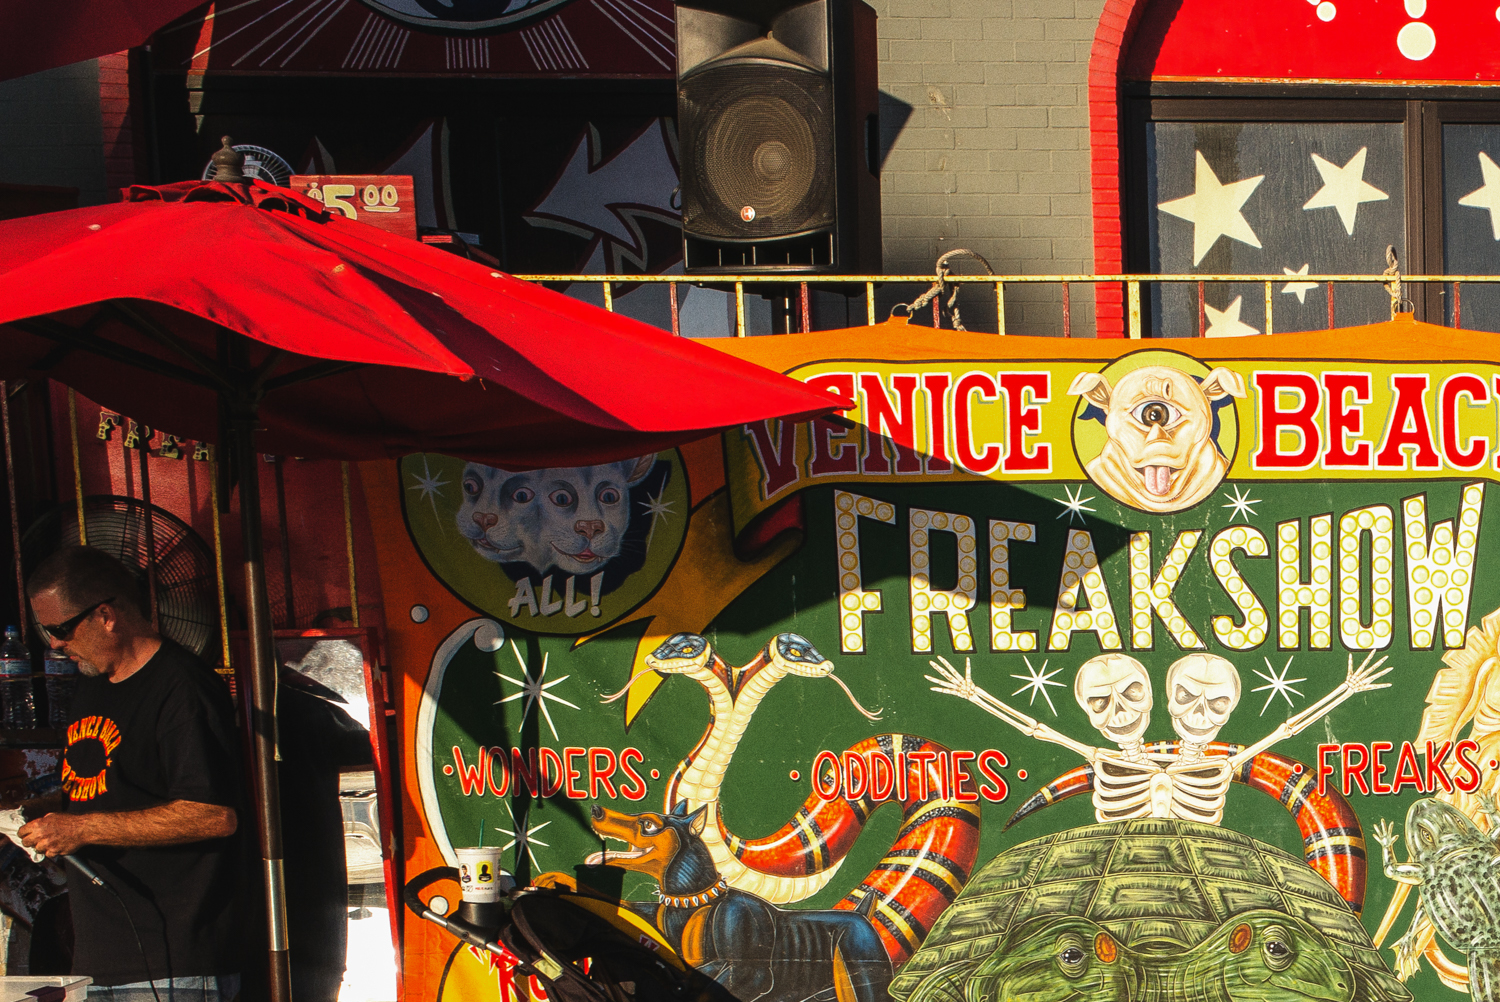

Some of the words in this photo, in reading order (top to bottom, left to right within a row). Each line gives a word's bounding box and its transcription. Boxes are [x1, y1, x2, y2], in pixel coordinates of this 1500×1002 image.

[744, 370, 1052, 500] VENICE
[507, 571, 604, 618] ALL!
[451, 745, 649, 801] WONDERS
[811, 749, 1009, 802] ODDITIES
[1316, 741, 1481, 797] FREAKS
